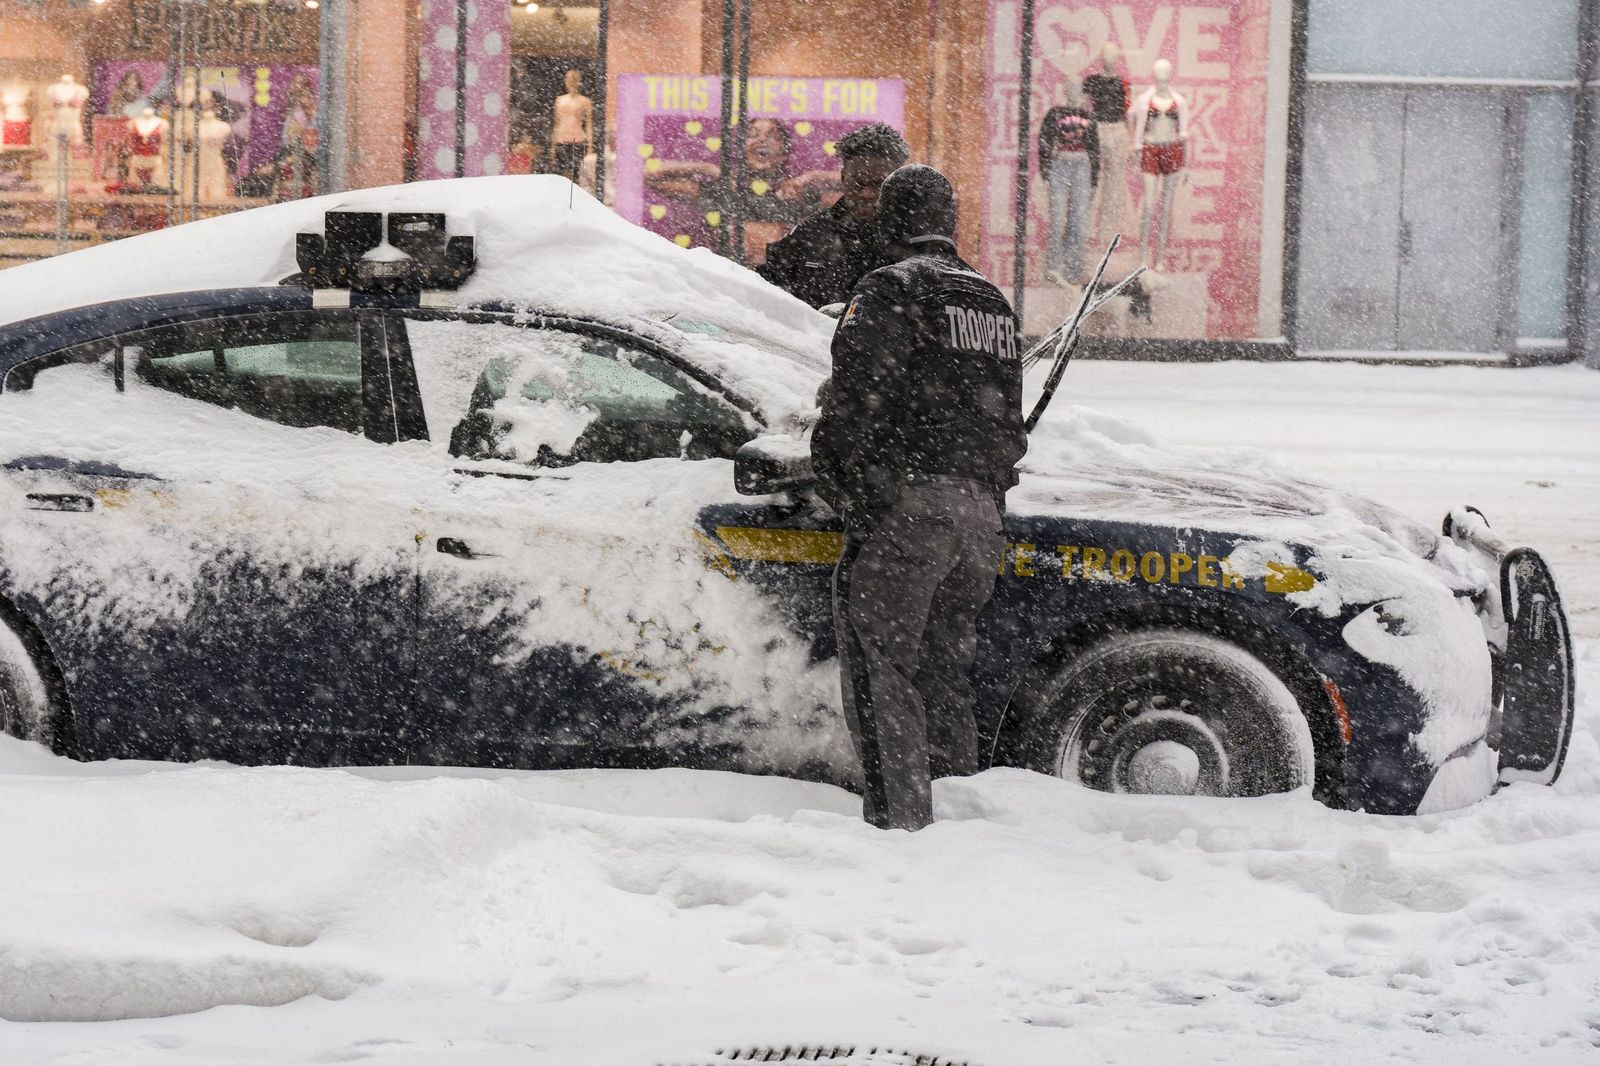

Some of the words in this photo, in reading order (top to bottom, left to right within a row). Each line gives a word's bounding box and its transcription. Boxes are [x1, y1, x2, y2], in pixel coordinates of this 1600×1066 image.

[643, 76, 709, 112] THIS
[731, 78, 808, 114] NE'S
[823, 81, 878, 115] FOR
[944, 305, 1018, 360] TROOPER
